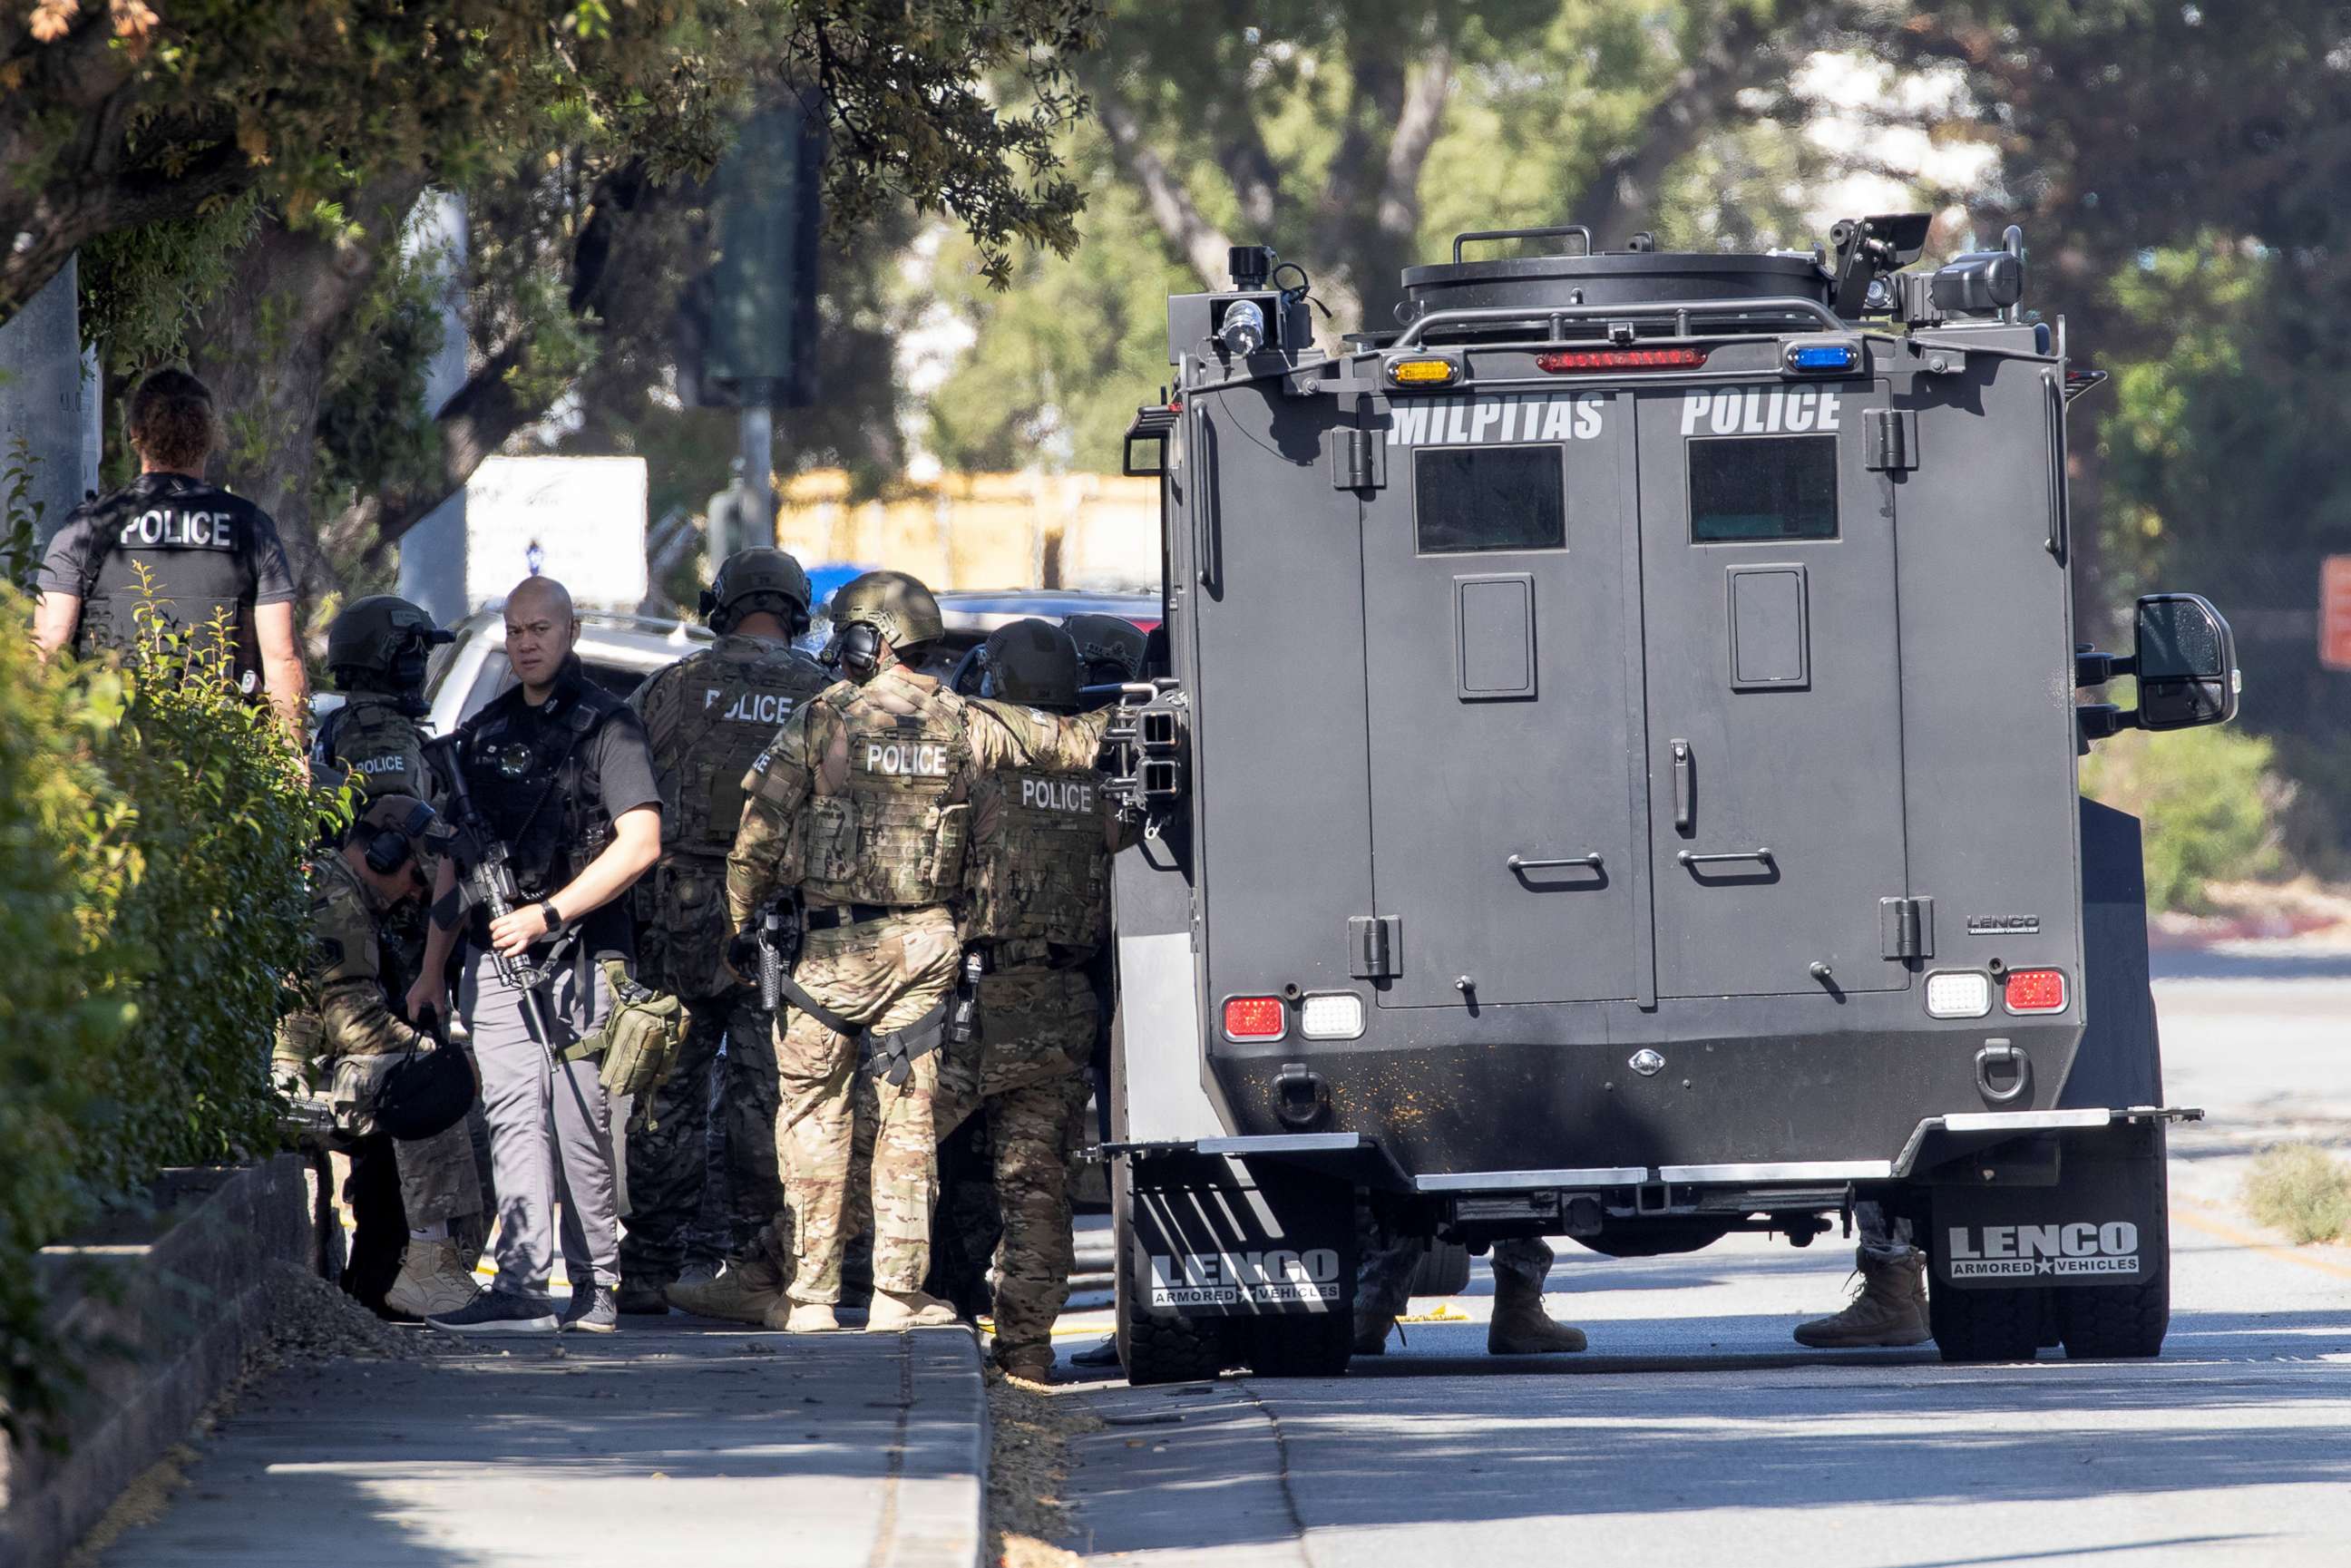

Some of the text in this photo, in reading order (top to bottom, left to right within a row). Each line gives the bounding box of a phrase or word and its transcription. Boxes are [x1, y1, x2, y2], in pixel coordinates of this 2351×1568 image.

[1386, 385, 1842, 445] MILPITAS POLICE
[120, 509, 230, 546] POLICE
[356, 755, 405, 774] POLICE
[866, 744, 948, 774] POLICE
[1022, 779, 1092, 813] POLICE
[1966, 914, 2039, 929] LENCO
[1948, 1222, 2138, 1259] LENCO
[1151, 1249, 1339, 1288] LENCO
[1954, 1259, 2137, 1274] ARMORED VEHICLES
[1156, 1286, 1337, 1304] ARMORED VEHICLES
